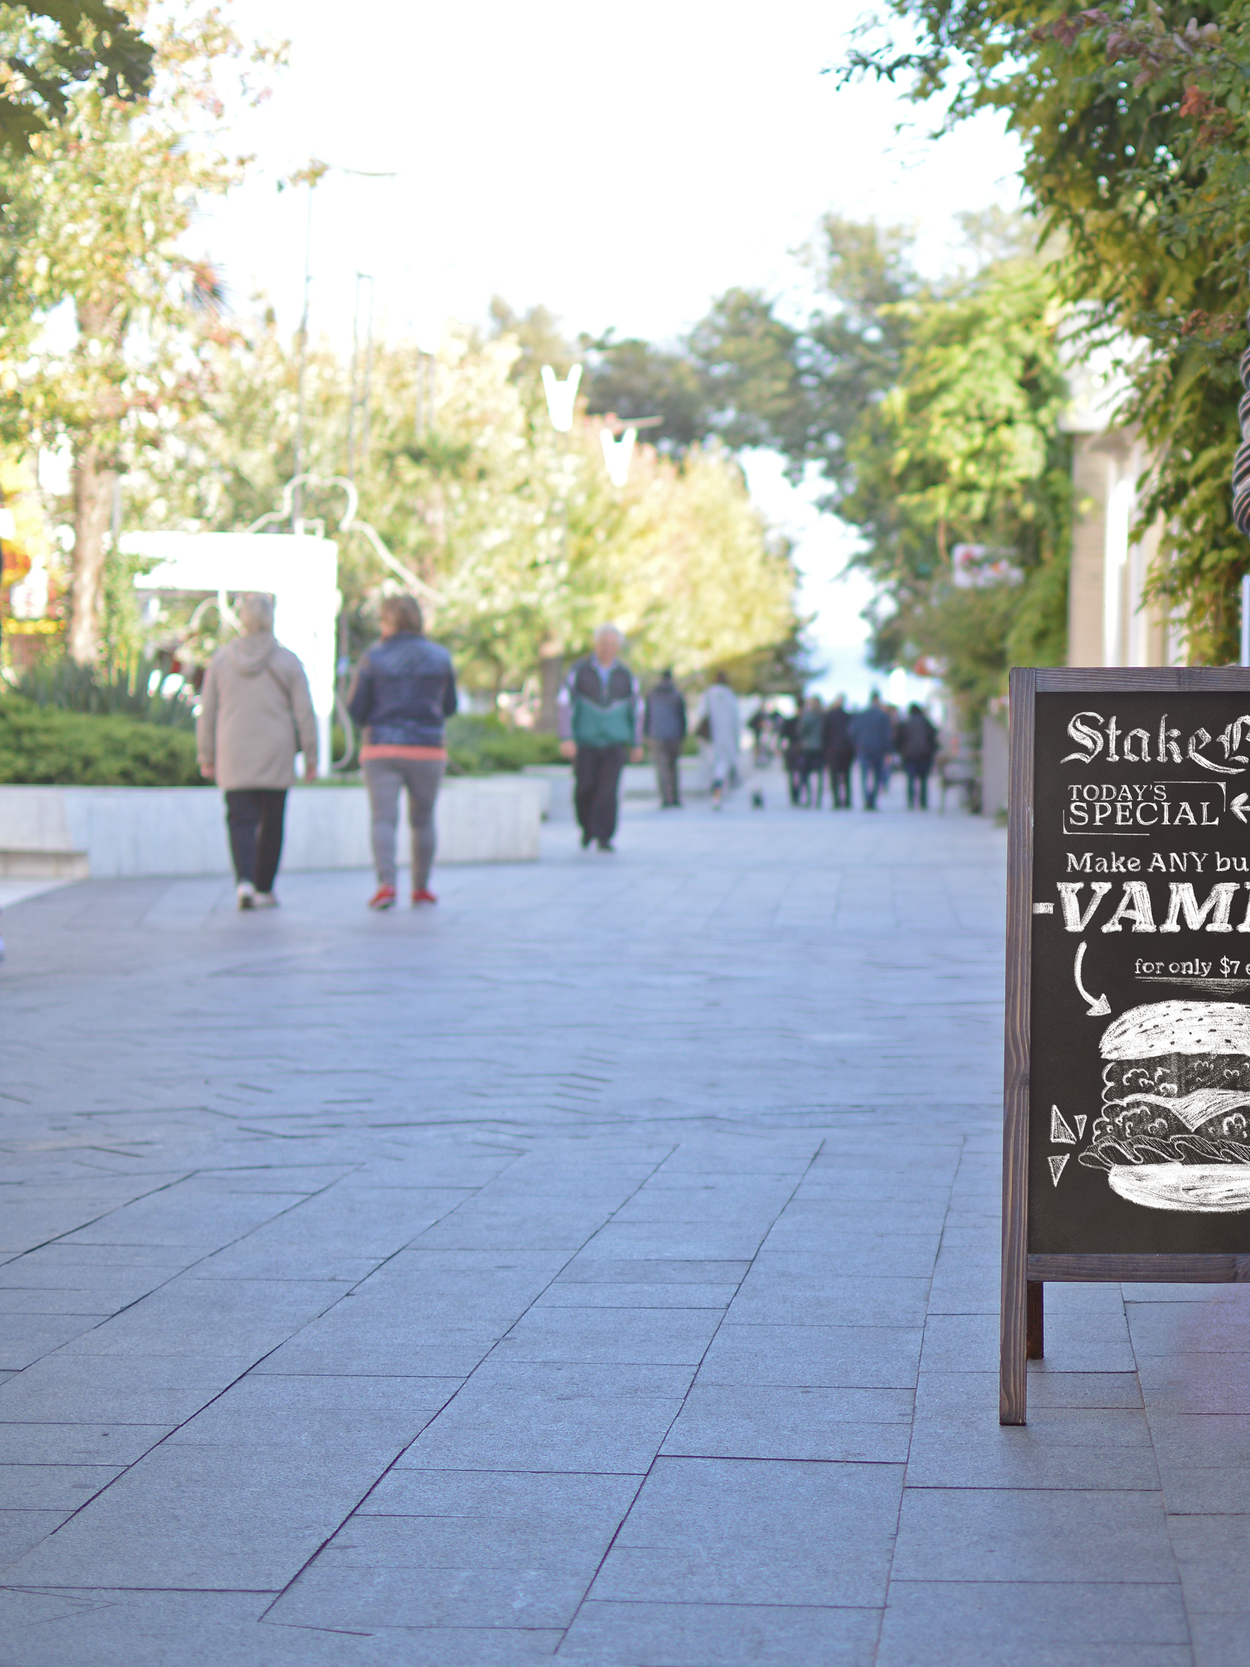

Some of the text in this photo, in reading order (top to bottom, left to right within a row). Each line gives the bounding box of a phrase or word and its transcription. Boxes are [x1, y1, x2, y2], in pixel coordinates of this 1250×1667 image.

[1068, 784, 1168, 801] TODAY'S
[1069, 802, 1220, 826] SPECIAL
[1066, 852, 1142, 873] Make
[1147, 852, 1209, 873] ANY
[1135, 958, 1165, 975] for
[1169, 958, 1213, 979] only
[1219, 955, 1241, 976] $7
